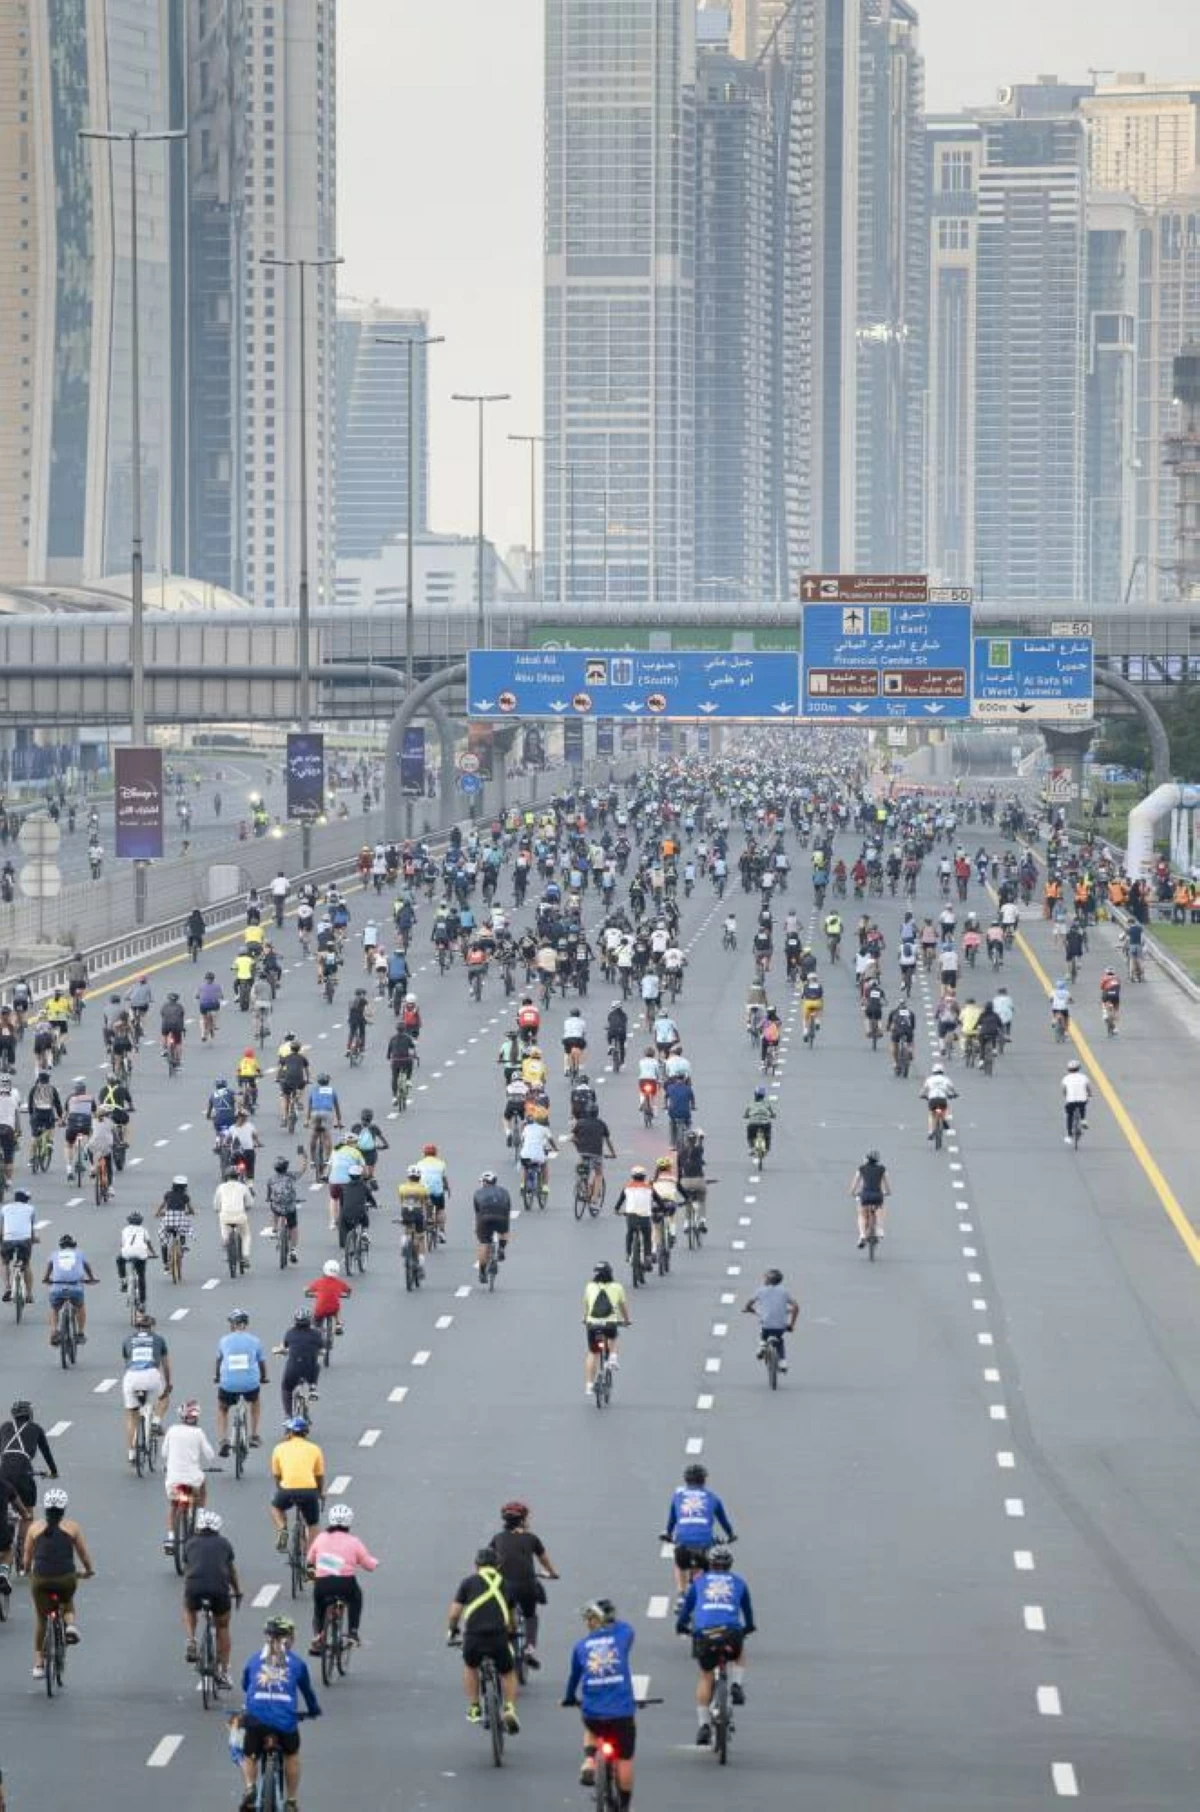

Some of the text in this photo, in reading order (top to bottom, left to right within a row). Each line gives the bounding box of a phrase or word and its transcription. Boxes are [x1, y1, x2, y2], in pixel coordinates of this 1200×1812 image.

[951, 590, 969, 601] 50
[896, 624, 928, 635] (East)
[1072, 623, 1089, 634] 50
[833, 655, 878, 665] Financial
[982, 686, 1018, 697] (West)
[807, 702, 837, 712] 300m
[979, 703, 1007, 712] 600m
[119, 783, 159, 801] Disney+
